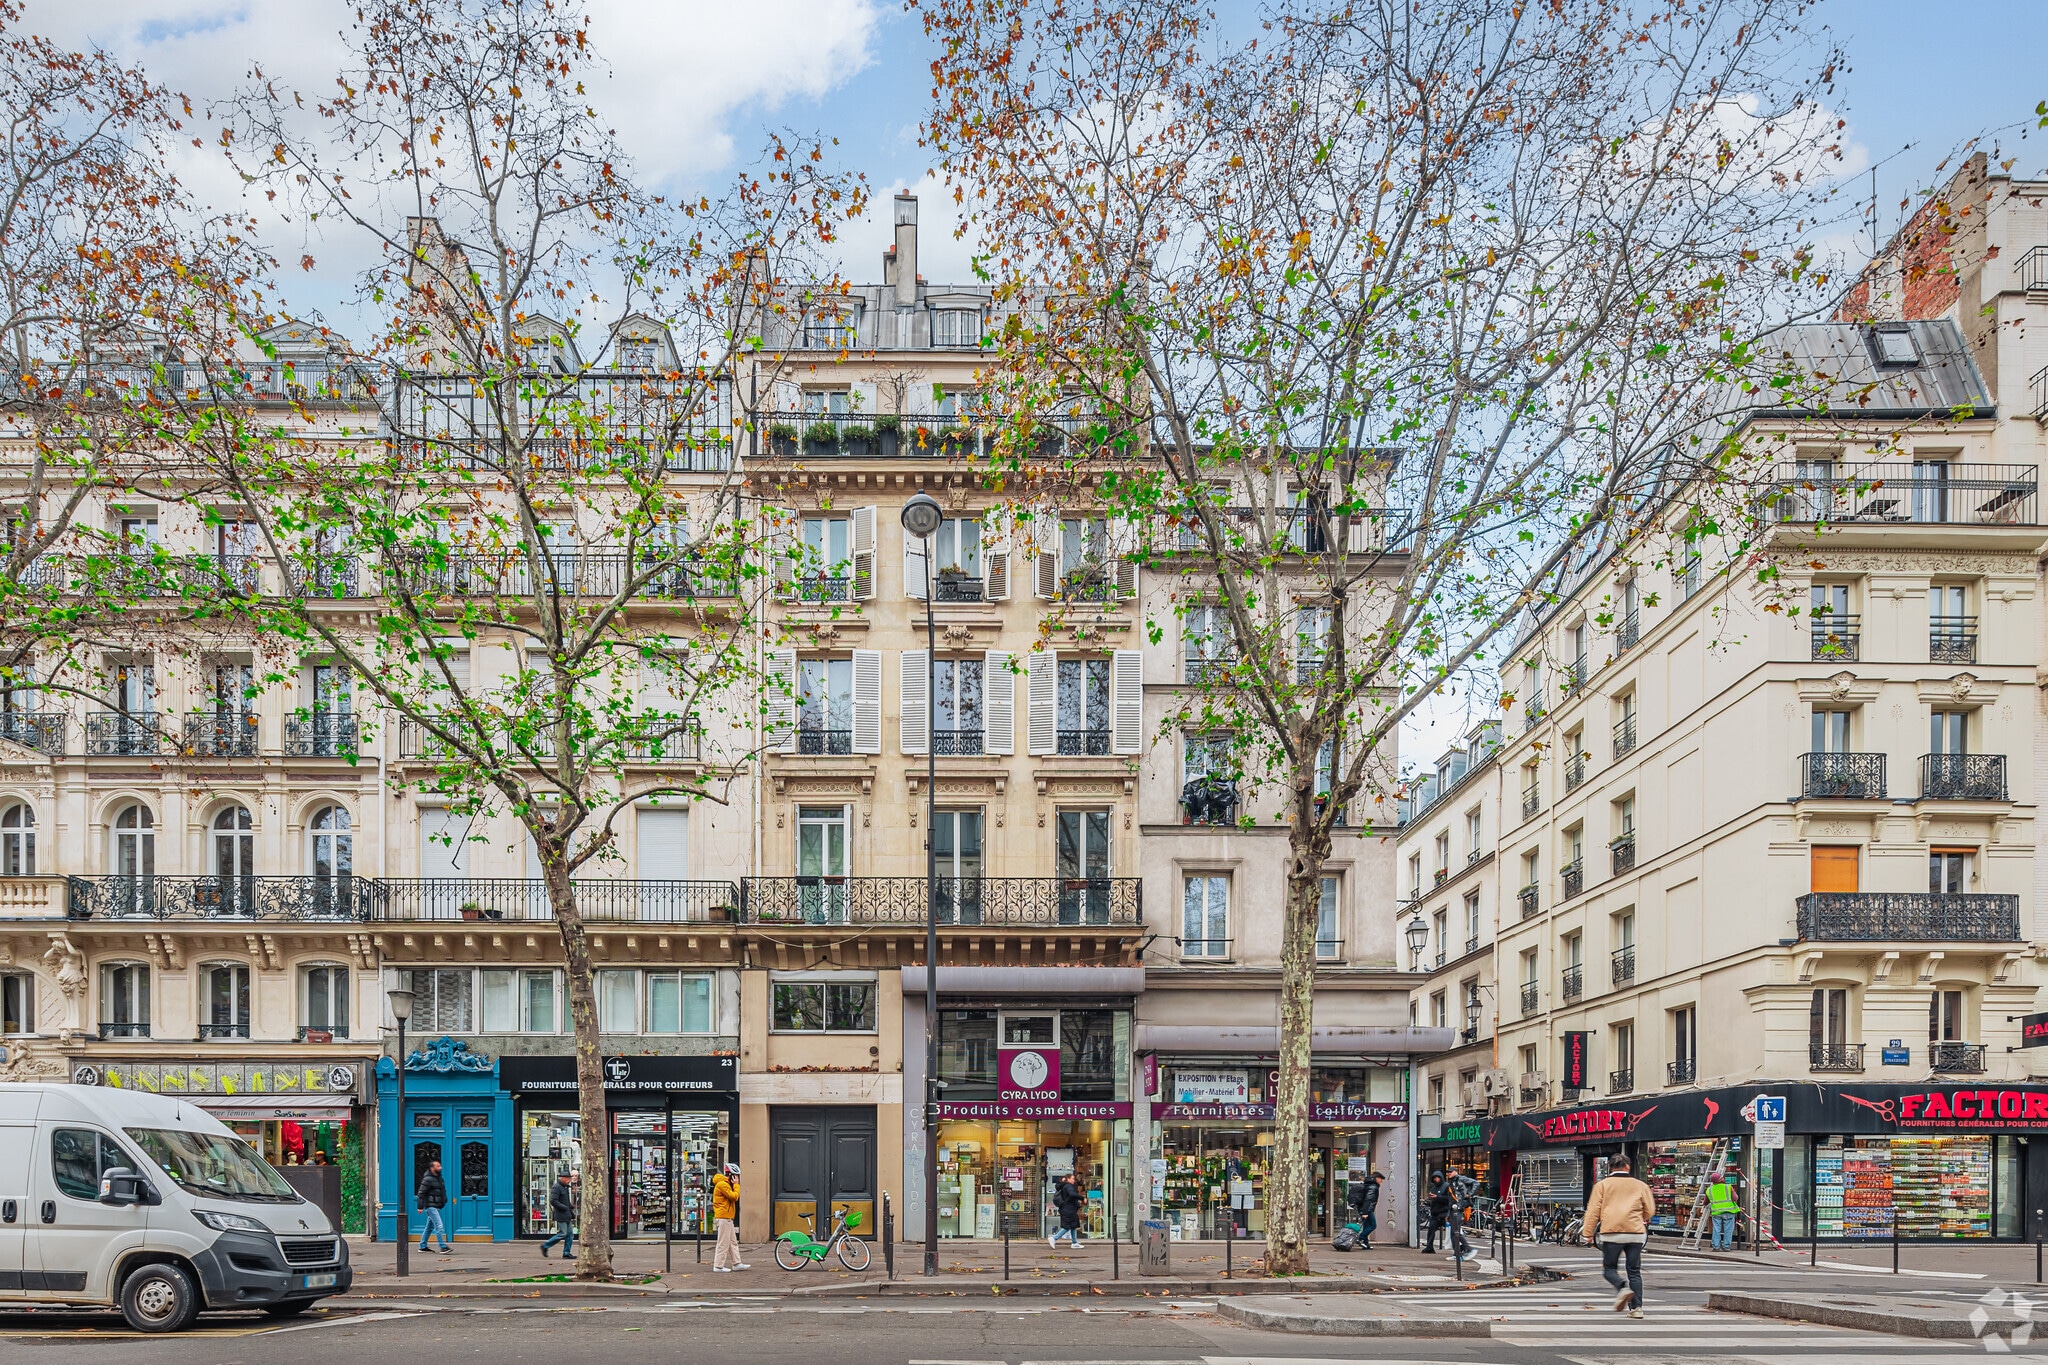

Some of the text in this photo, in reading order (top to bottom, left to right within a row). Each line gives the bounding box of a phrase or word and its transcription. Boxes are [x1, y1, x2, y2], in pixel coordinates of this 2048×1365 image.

[1572, 1034, 1581, 1086] FACTORY
[603, 1080, 637, 1089] ÉRALES
[639, 1081, 663, 1089] POUR
[665, 1081, 713, 1089] COIFFEURS
[1226, 1075, 1244, 1085] Etage
[1001, 1090, 1058, 1100] CYRA LYDO
[1208, 1087, 1235, 1096] Matériel
[1316, 1104, 1404, 1116] coiffeurs 27
[1899, 1091, 2048, 1118] FACTOR
[226, 1109, 256, 1117] féminin
[944, 1104, 1009, 1116] Produits
[1016, 1104, 1116, 1117] cosmétiques
[1174, 1105, 1265, 1116] Fournitures
[1545, 1110, 1626, 1136] FACTORY
[1958, 1118, 2005, 1128] GÉNÉRALES
[1447, 1122, 1481, 1141] andrex
